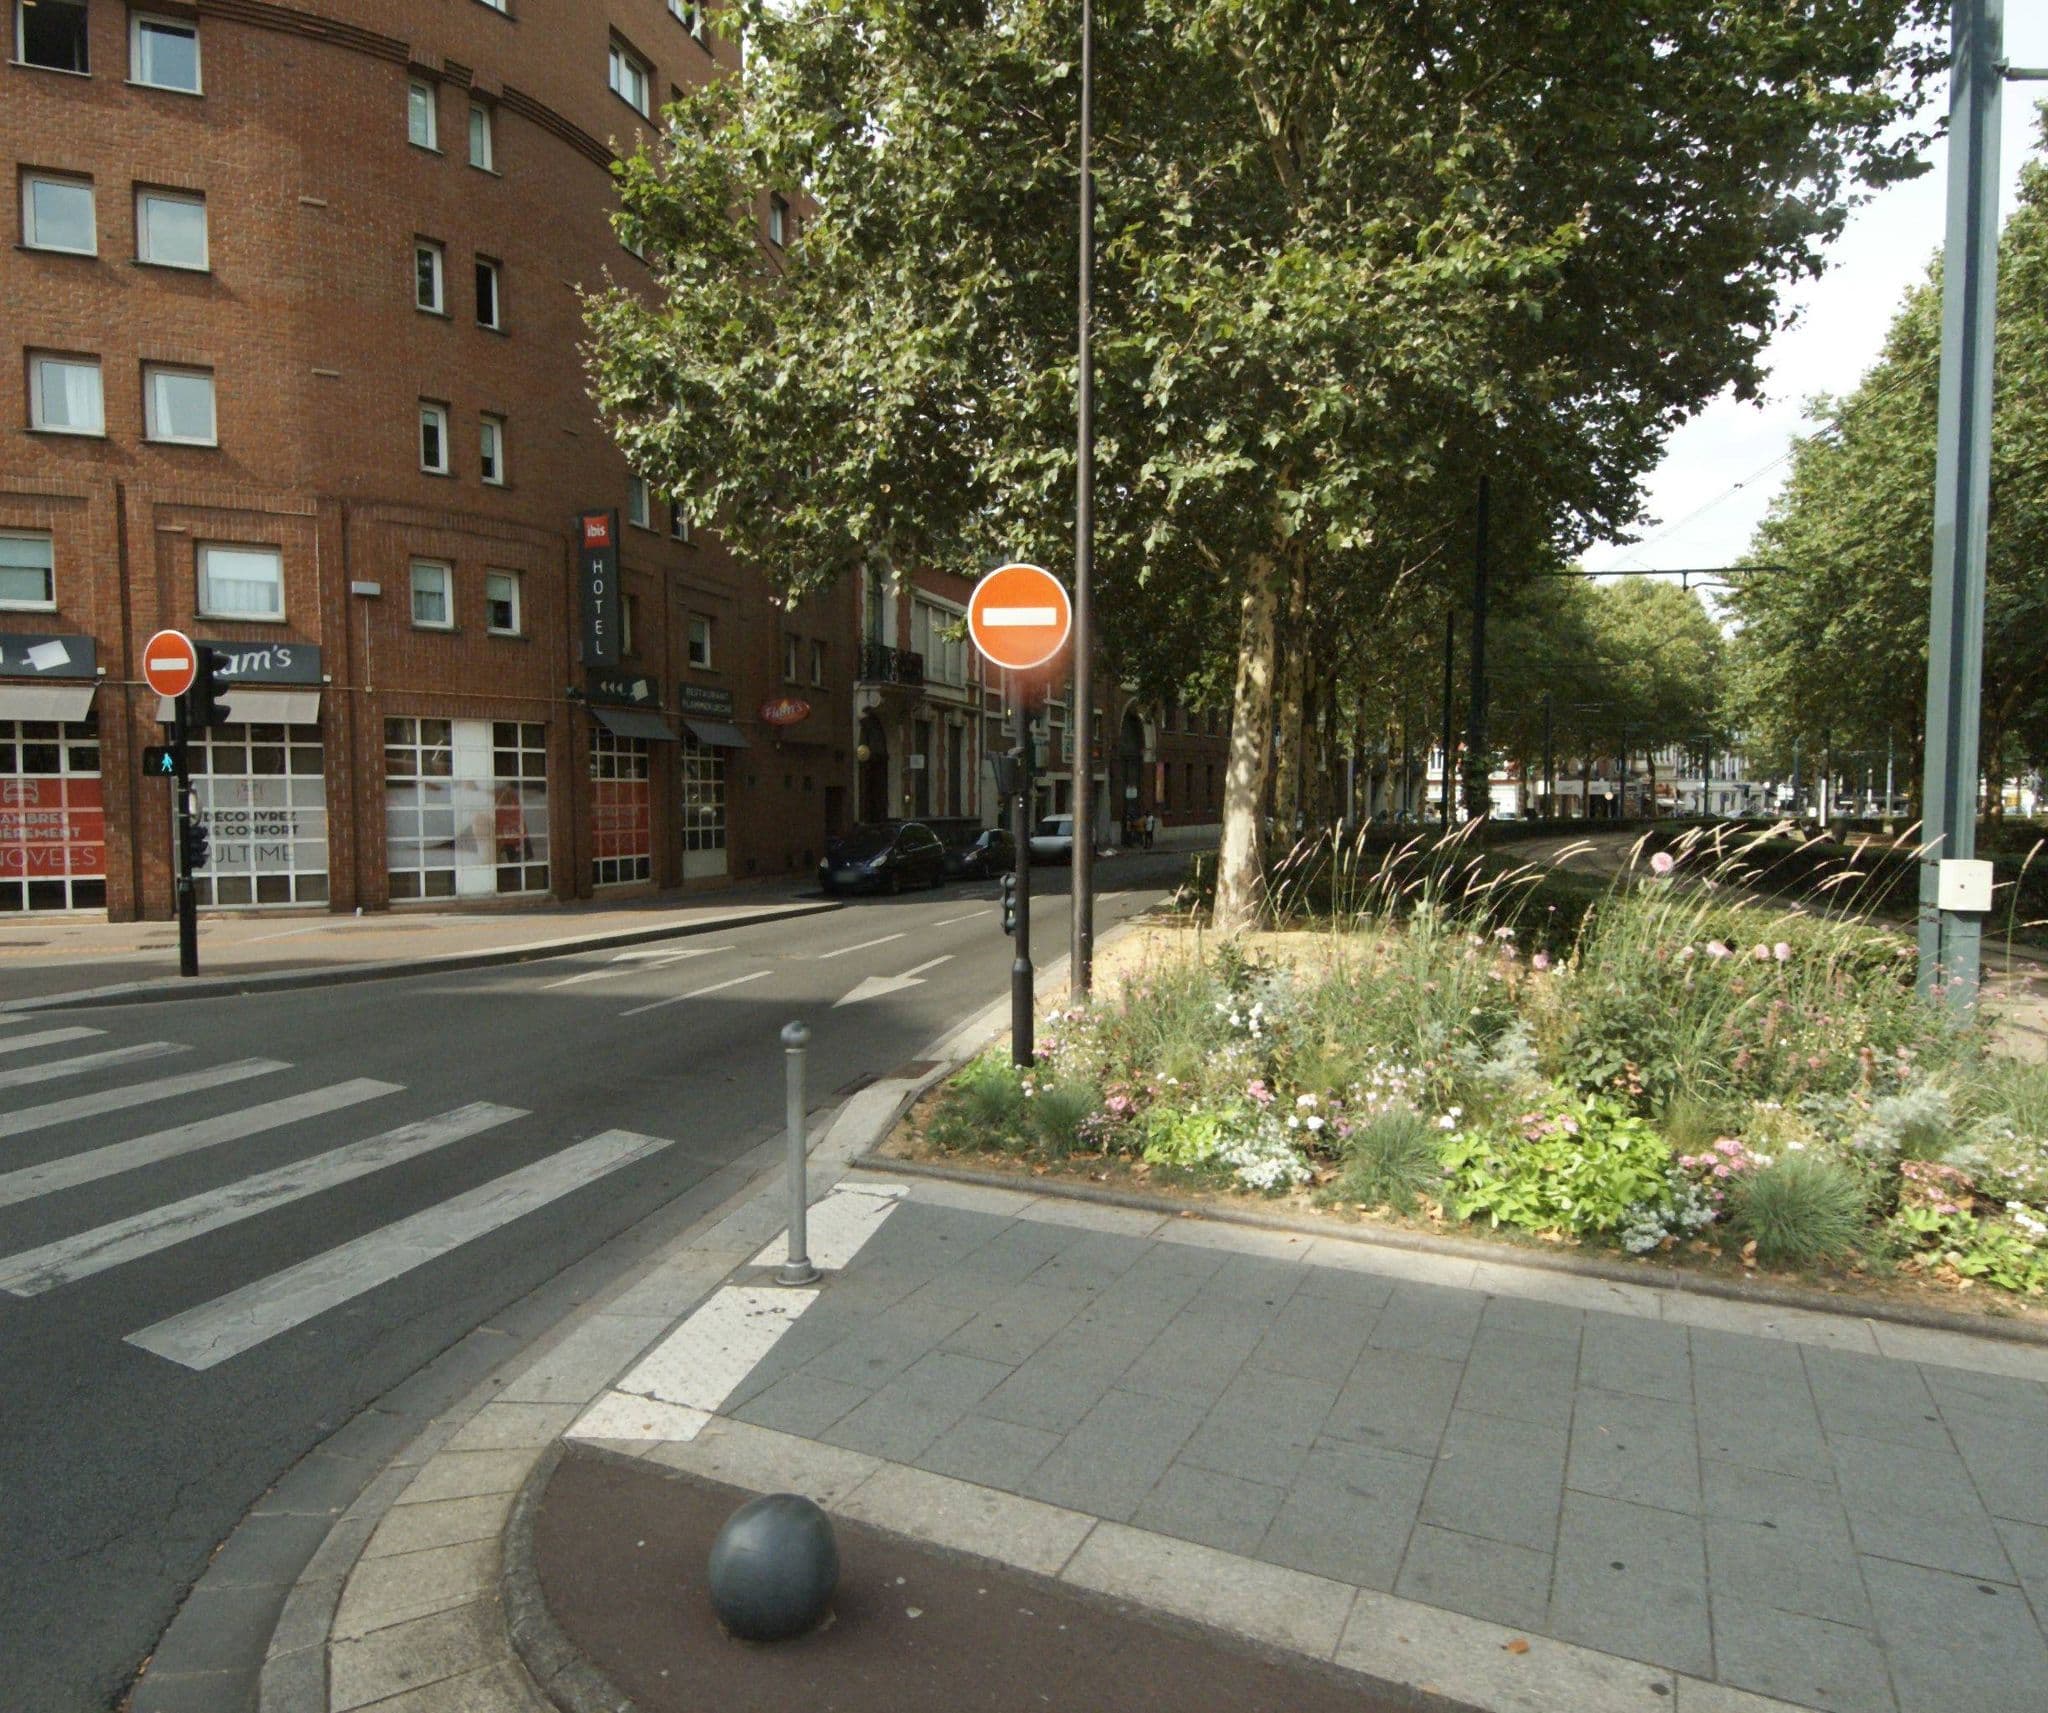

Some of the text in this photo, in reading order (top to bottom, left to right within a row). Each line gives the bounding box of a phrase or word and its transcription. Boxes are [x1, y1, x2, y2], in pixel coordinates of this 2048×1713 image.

[587, 524, 606, 537] ibis
[592, 559, 603, 655] HOTEL
[225, 824, 299, 837] CONFORT
